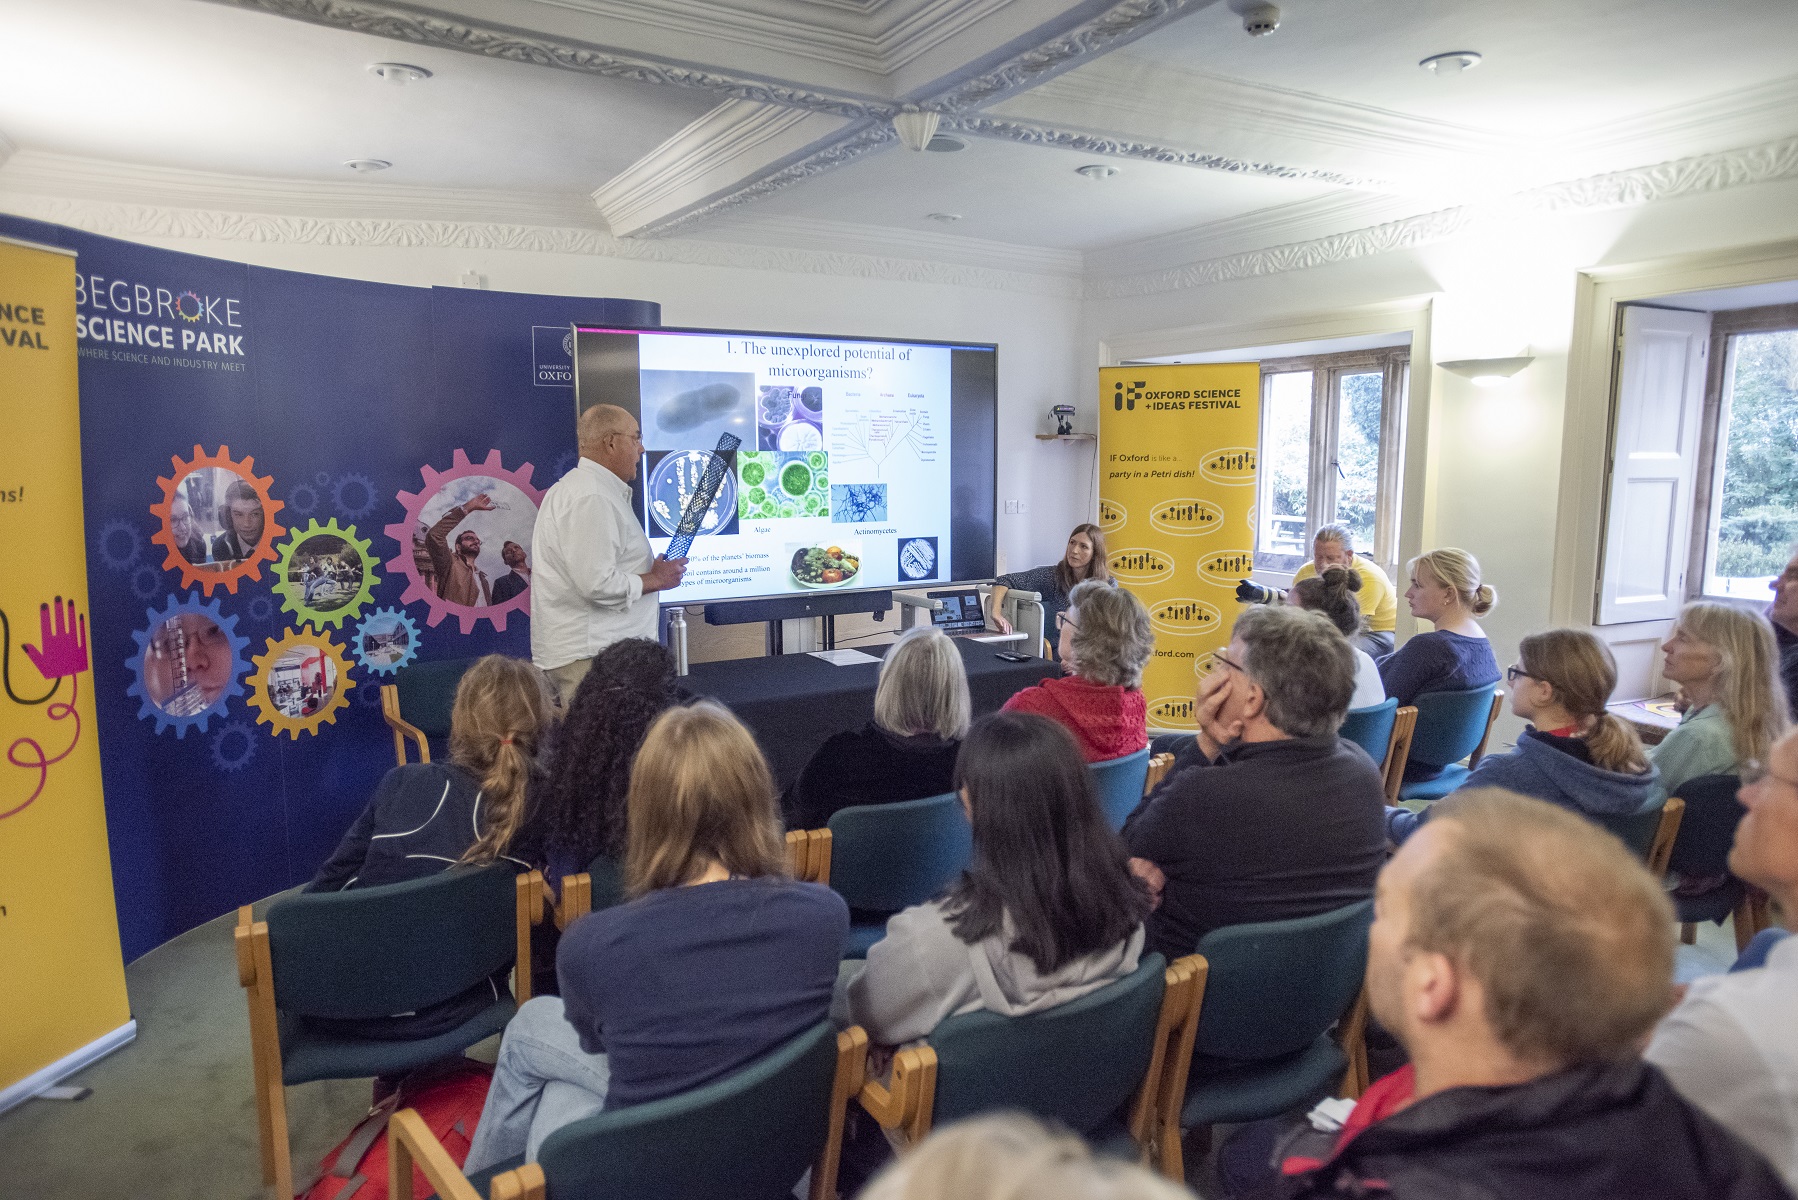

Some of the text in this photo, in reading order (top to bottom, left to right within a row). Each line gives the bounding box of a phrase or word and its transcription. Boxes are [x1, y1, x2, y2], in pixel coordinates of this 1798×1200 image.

[76, 273, 242, 327] BEGBROKE
[76, 314, 245, 356] SCIENCE PARK
[726, 341, 912, 361] 1. The unexplored potential of
[78, 347, 246, 372] WHERE SCIENCE AND INDUSTRY MEET
[768, 363, 873, 381] microorganisms?
[1145, 389, 1241, 400] OXFORD SCIENCE
[1153, 402, 1186, 411] IDEAS
[1188, 400, 1241, 410] FESTIVAL
[1109, 454, 1117, 462] IF
[1119, 454, 1150, 462] Oxford
[1158, 454, 1171, 462] like
[1109, 470, 1132, 480] party
[1133, 470, 1142, 478] in
[1151, 470, 1172, 478] Petri
[1173, 470, 1195, 478] dish!
[754, 526, 771, 534] Algae
[854, 527, 897, 536] Actinomycetes
[745, 552, 769, 560] biomass
[696, 568, 721, 576] contains
[749, 565, 771, 573] million
[681, 575, 752, 588] ypes of microorganisms
[1152, 649, 1194, 658] ford.com
